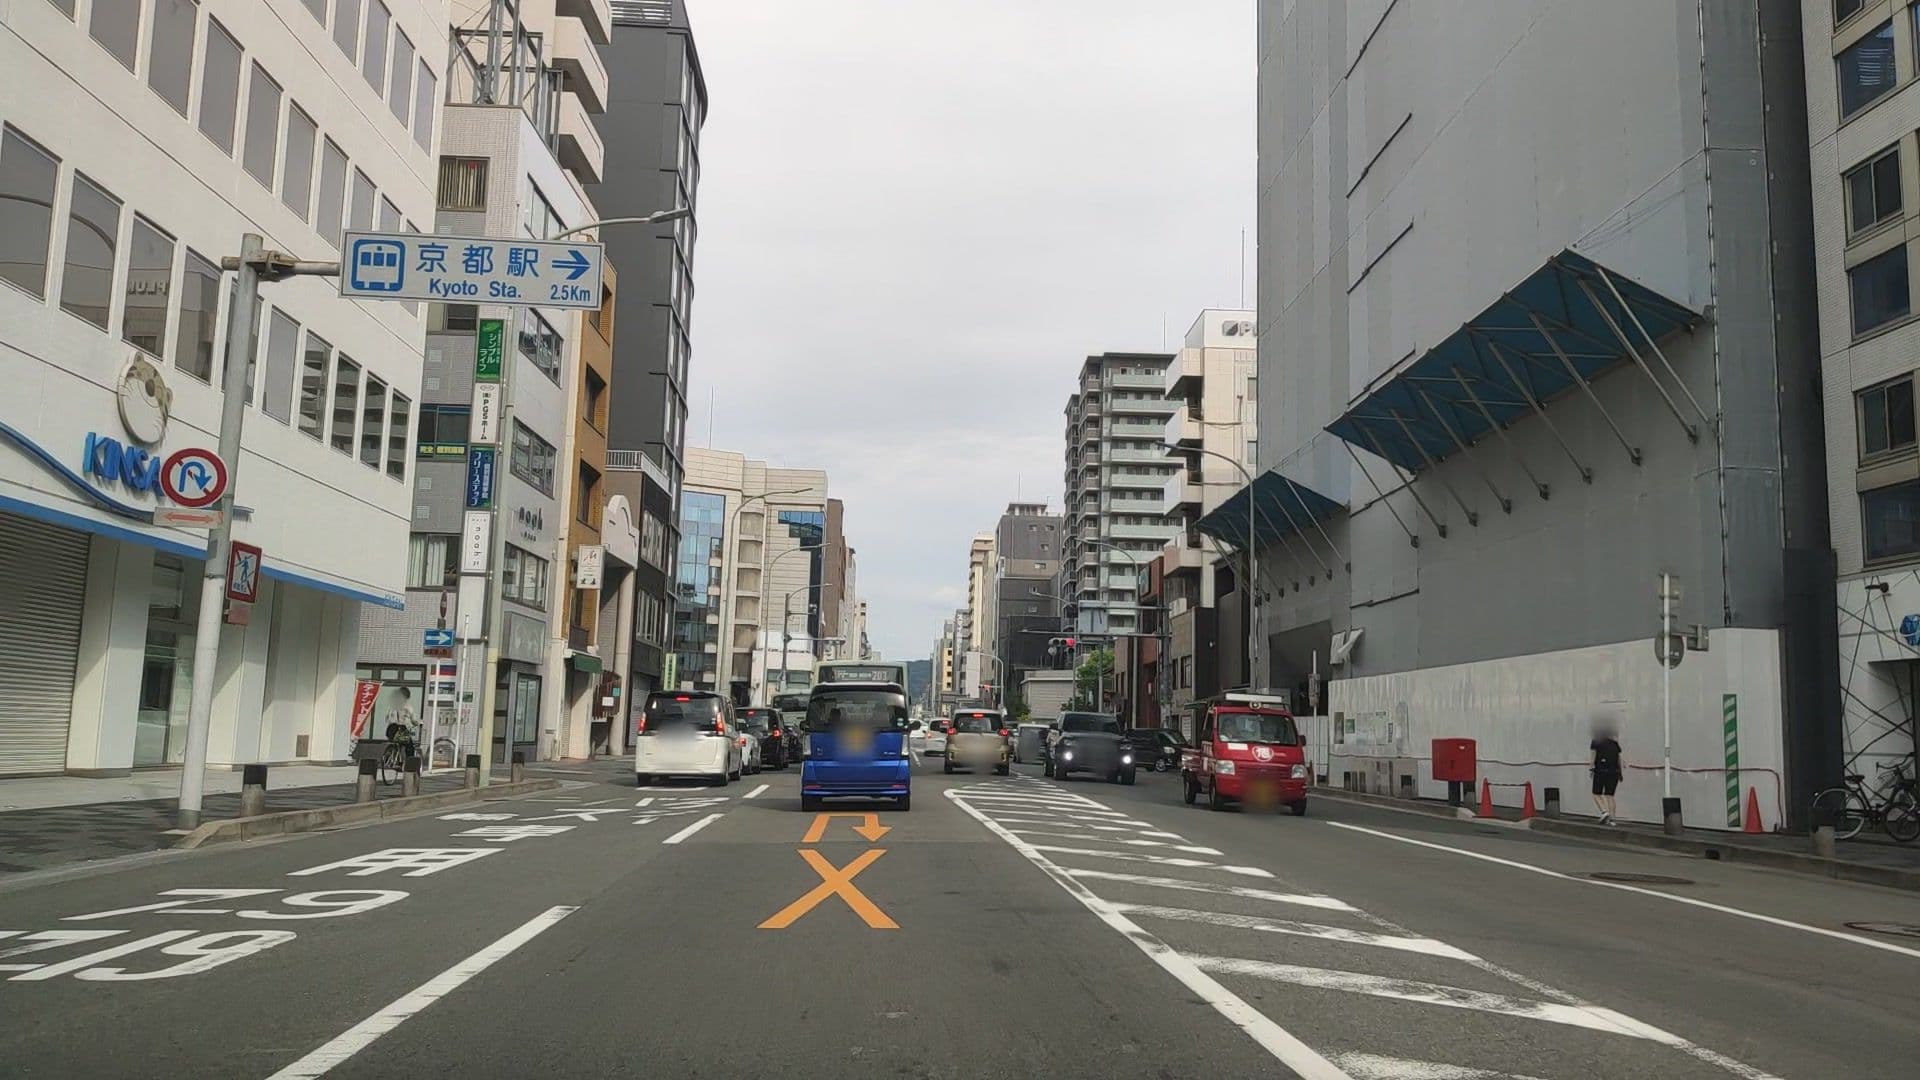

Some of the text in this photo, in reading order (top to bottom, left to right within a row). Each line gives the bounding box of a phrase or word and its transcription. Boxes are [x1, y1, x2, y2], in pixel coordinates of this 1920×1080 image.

[415, 241, 539, 277] 京都駅
[429, 277, 522, 298] Kyoto Sta.
[550, 284, 591, 302] 2.5Km
[871, 670, 888, 681] 203
[0, 929, 298, 982] 7-19
